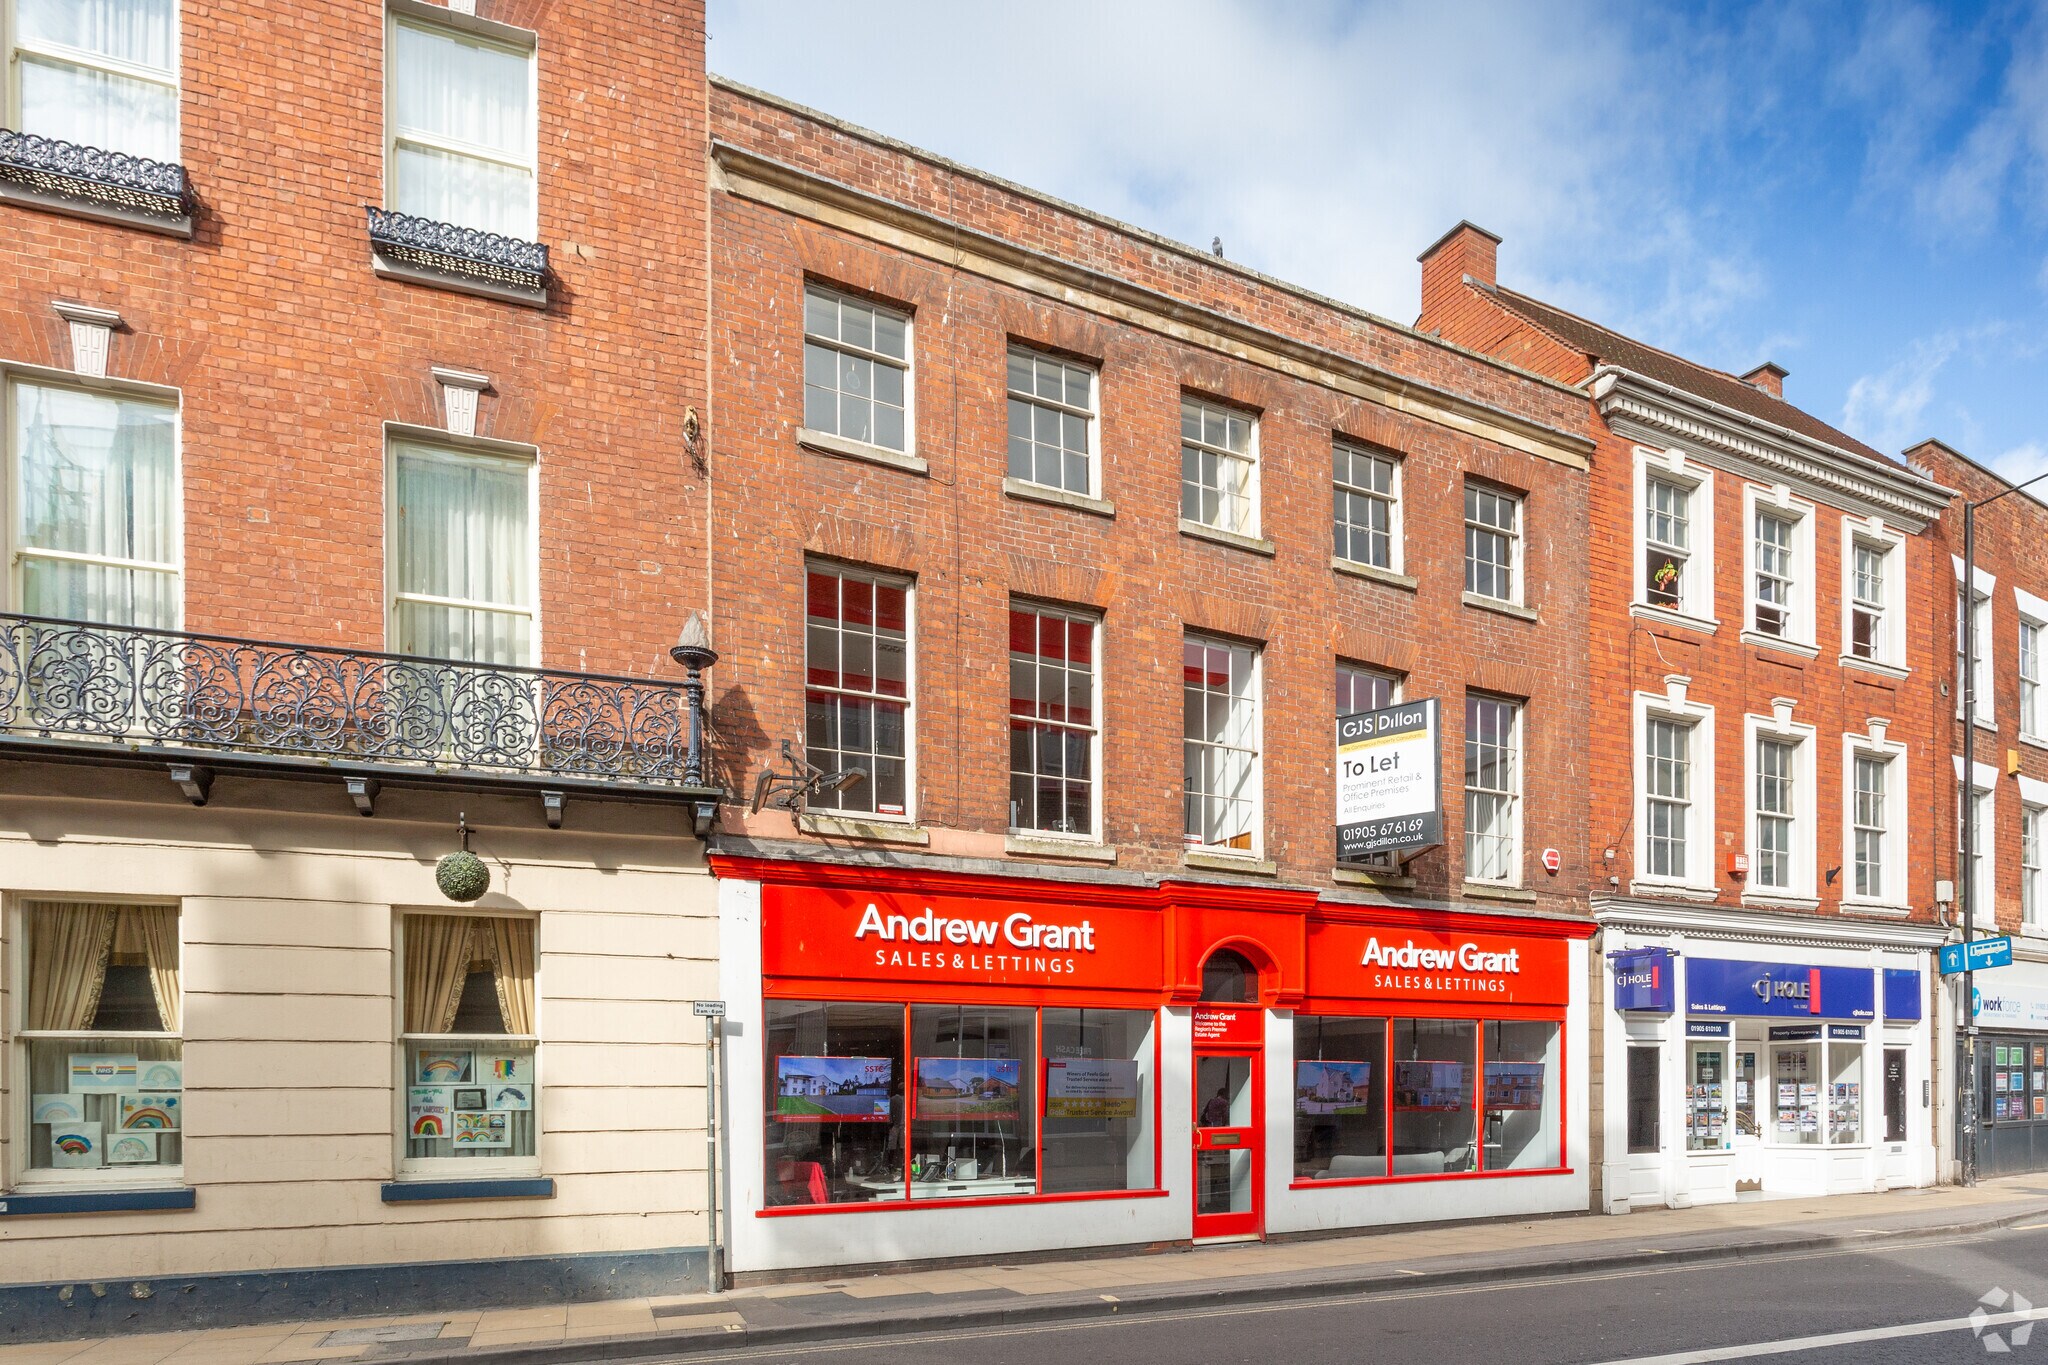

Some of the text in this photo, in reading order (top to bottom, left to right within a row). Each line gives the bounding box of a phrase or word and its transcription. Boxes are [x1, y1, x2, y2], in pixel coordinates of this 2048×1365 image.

[1343, 712, 1422, 737] GJS Dillon
[1377, 738, 1395, 746] Property
[1343, 752, 1400, 778] To Let
[1343, 772, 1422, 792] Prominent Retail &
[1343, 785, 1409, 802] Office Premises
[1344, 802, 1386, 814] All Enquiries
[1343, 825, 1376, 841] 01905
[1344, 833, 1423, 849] www.gjsdillon.co.uk
[855, 904, 1095, 950] Andrew Grant
[1361, 937, 1520, 973] Andrew Grant
[1628, 973, 1652, 984] HOLE
[1774, 981, 1810, 998] HOLE
[1708, 1004, 1726, 1012] Lettings
[1852, 1009, 1874, 1017] cjhole.com
[1195, 1012, 1236, 1021] Andrew Grant
